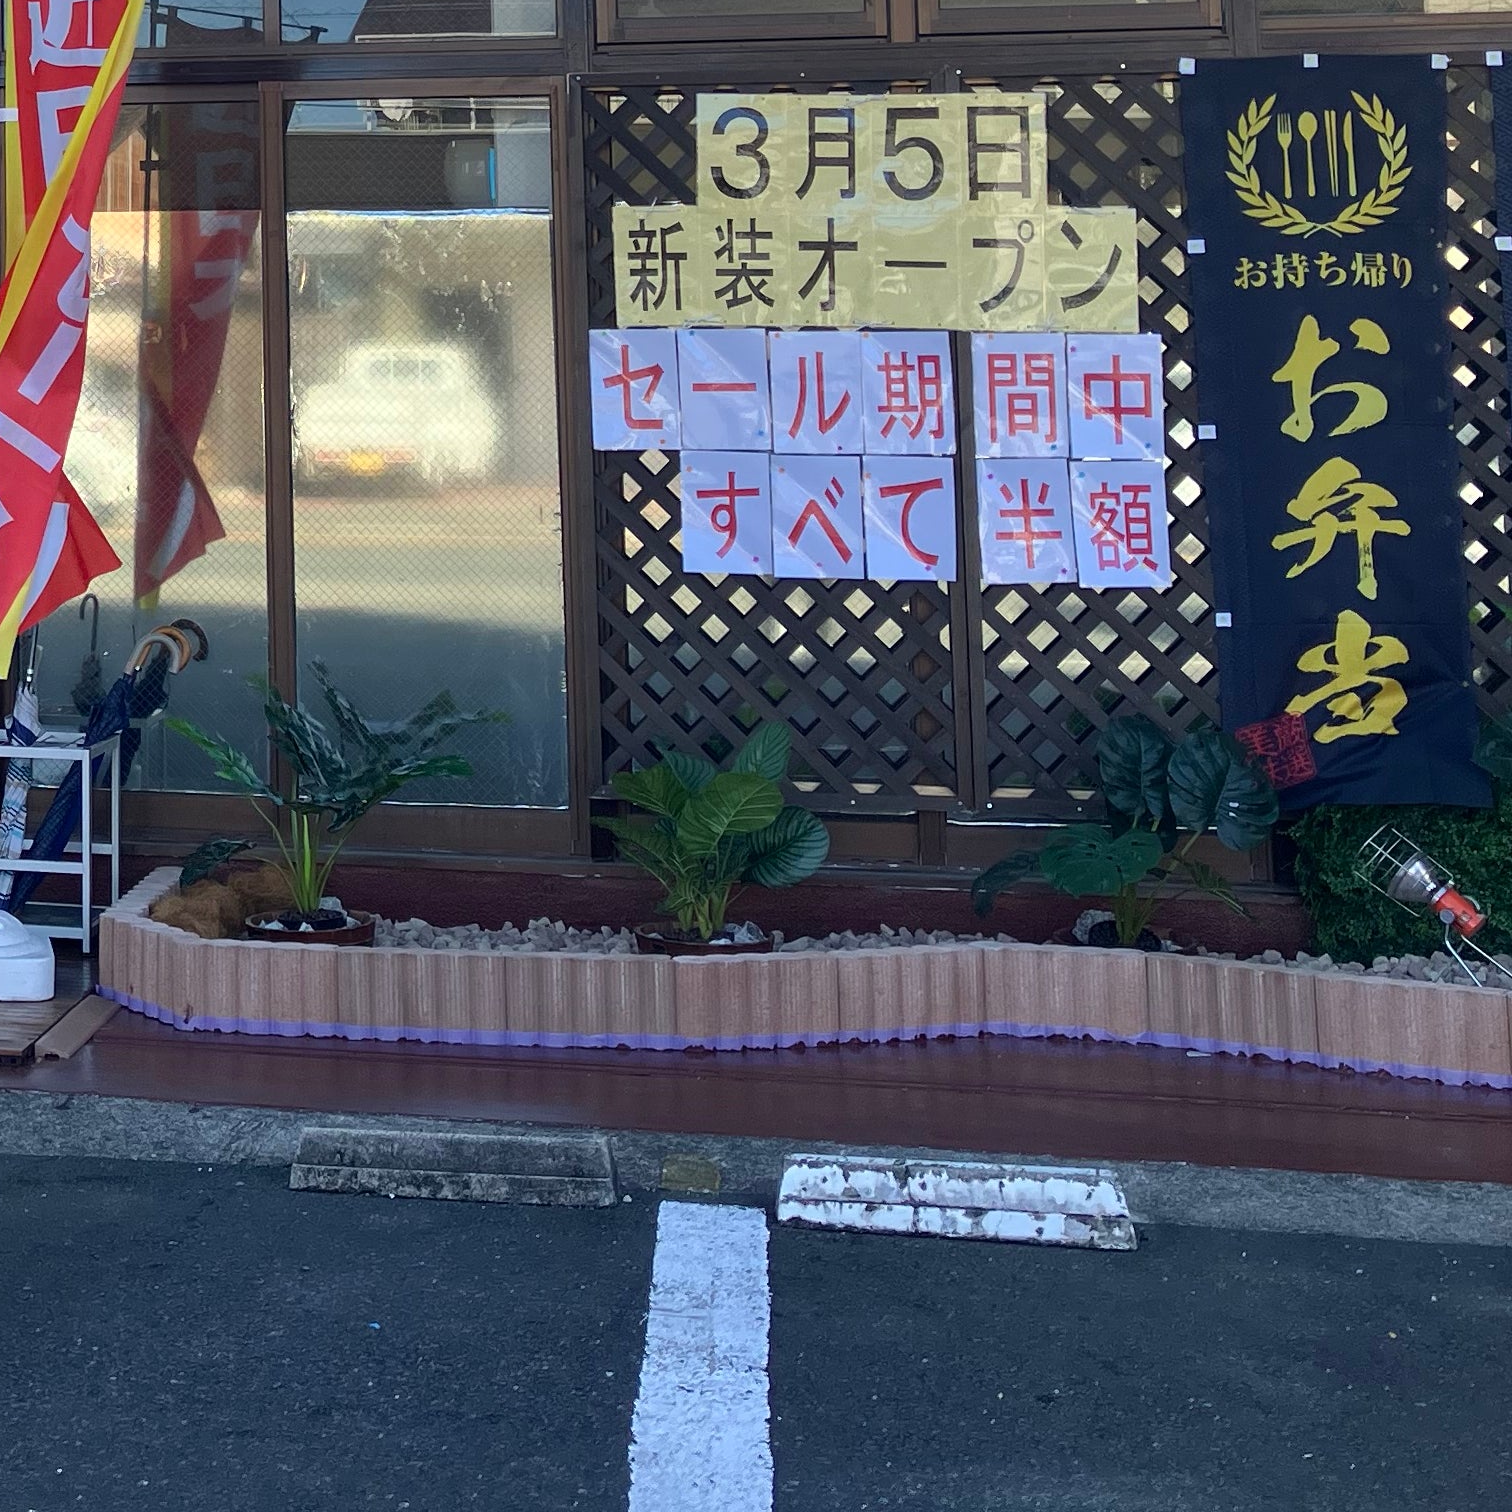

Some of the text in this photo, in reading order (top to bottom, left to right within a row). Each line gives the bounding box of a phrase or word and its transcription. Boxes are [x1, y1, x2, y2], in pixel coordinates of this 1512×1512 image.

[709, 105, 1034, 201] 3月5日
[627, 217, 1124, 313] 新装オープン
[1233, 251, 1413, 289] お持ち帰り
[602, 344, 1154, 445] セール期間中
[694, 470, 1158, 572] すべて半額
[1272, 313, 1412, 744] お弁当
